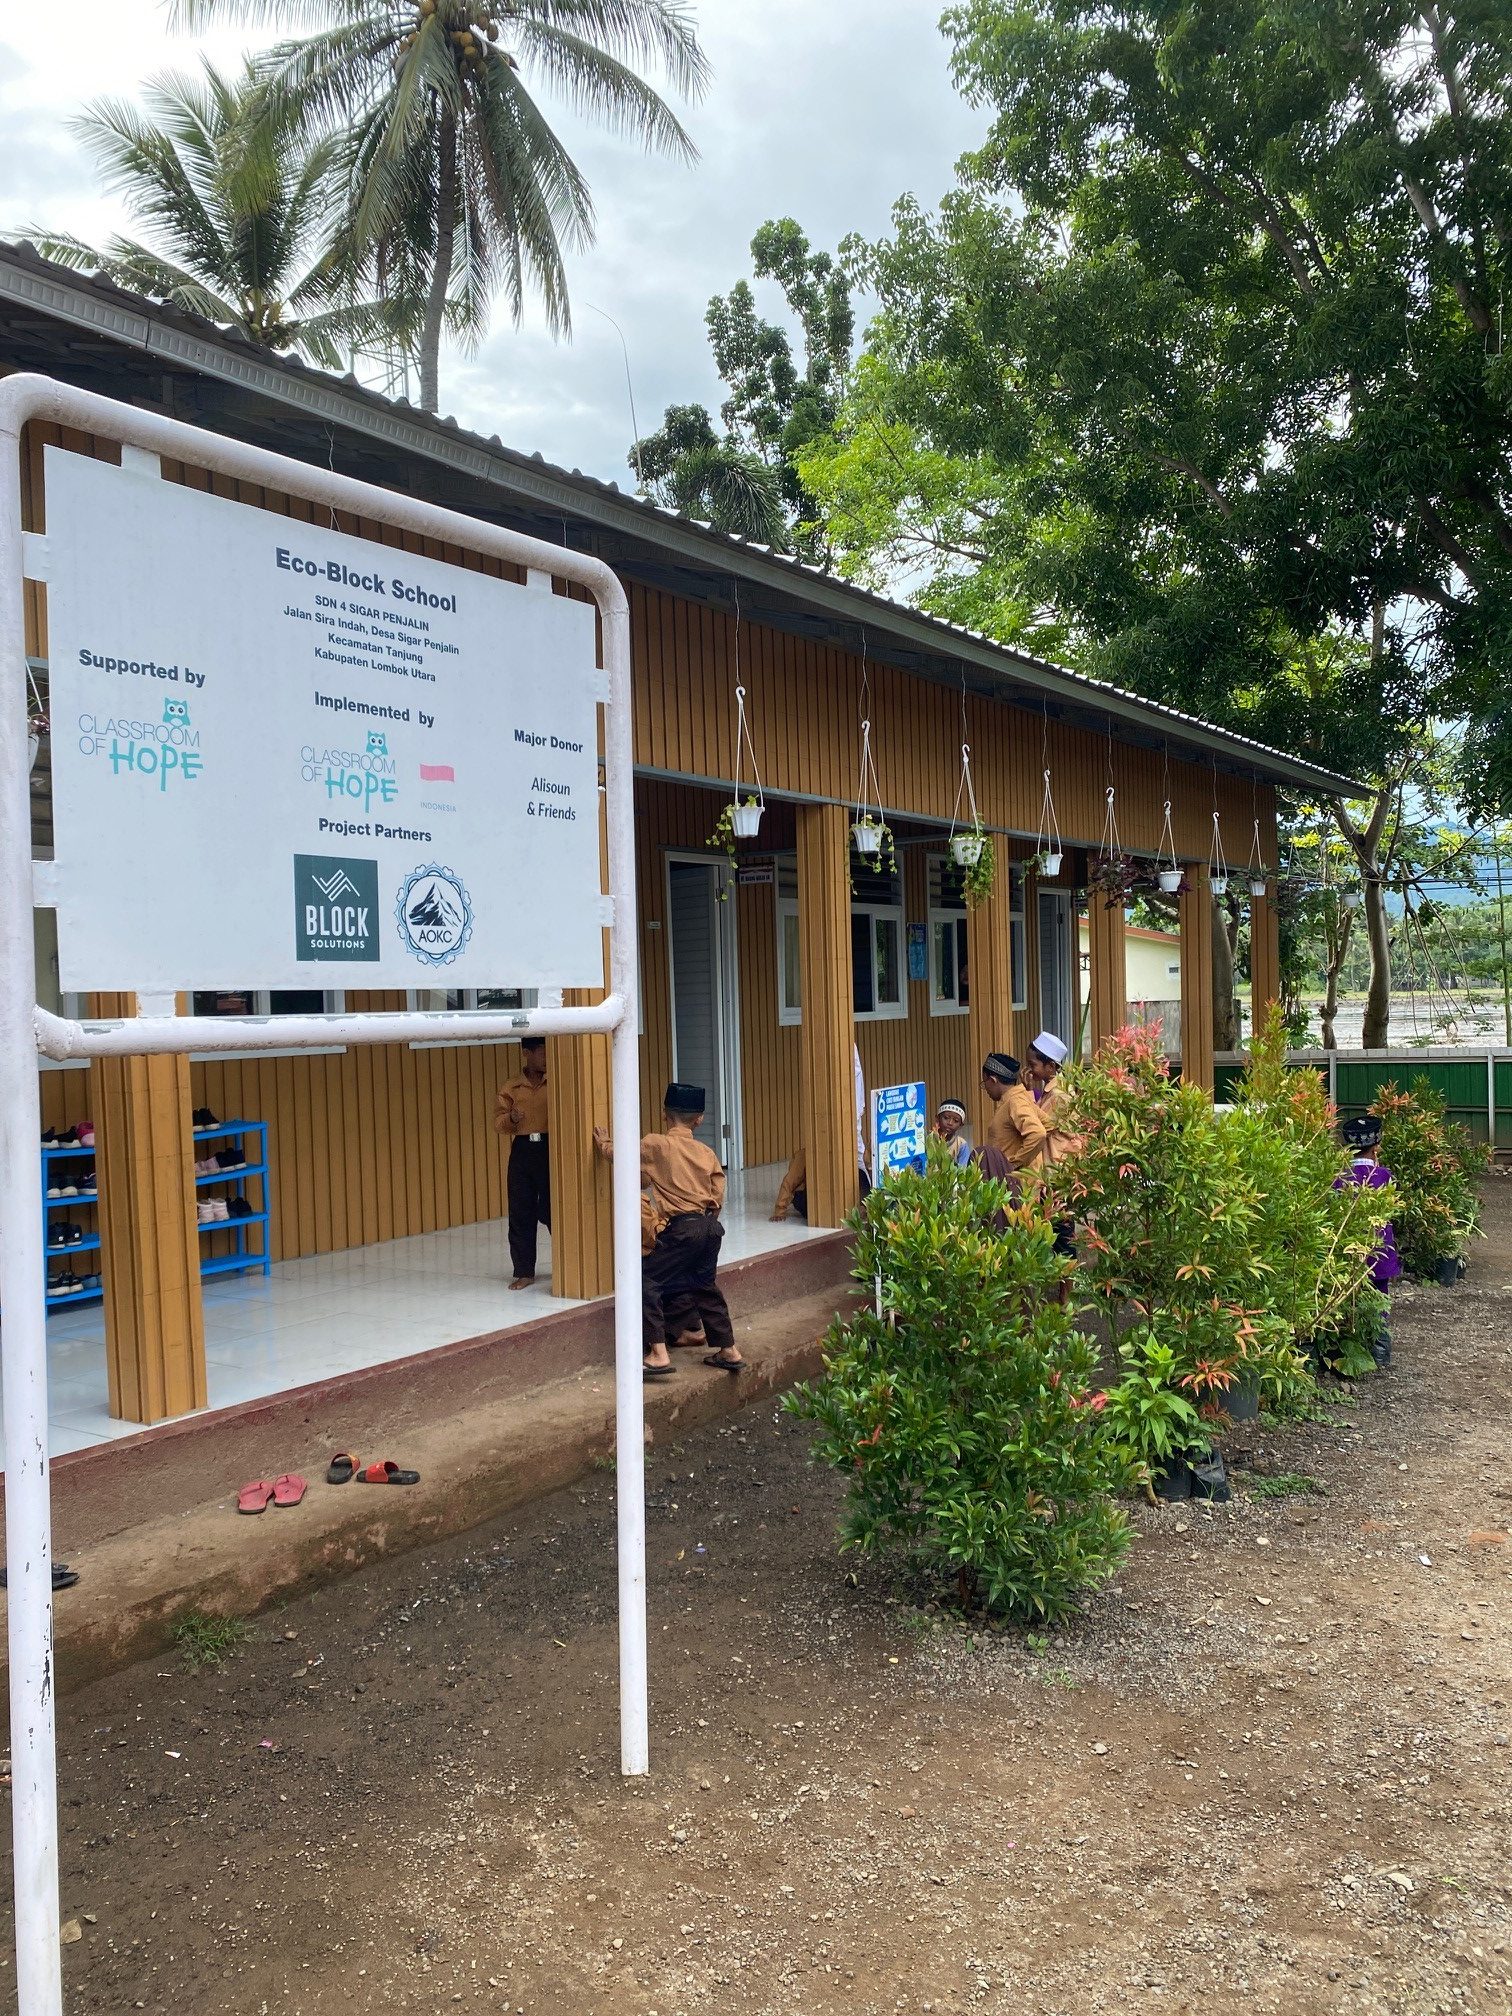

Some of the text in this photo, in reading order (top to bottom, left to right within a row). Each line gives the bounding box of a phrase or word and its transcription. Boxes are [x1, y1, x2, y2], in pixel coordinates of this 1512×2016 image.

[276, 547, 456, 613] Eco-Block School
[283, 605, 460, 655] Jalan Sira Indah, Desa Sigar Penjalin
[315, 595, 429, 632] SDN 4 SIGAR PENJALIN
[314, 647, 436, 682] Kabupaten Lombok Utara
[328, 632, 423, 665] Kecamatan Tanjung
[79, 649, 206, 688] Supported by
[315, 691, 435, 728] Implemented by
[79, 714, 200, 748] CLASSROOM
[514, 729, 584, 753] Major Donor
[79, 736, 204, 792] OF HOPE
[301, 745, 396, 774] CLASSROOM
[301, 765, 399, 813] OF HOPE
[531, 777, 571, 796] Alisoun
[420, 802, 457, 812] INDONESIA
[527, 801, 577, 821] & Friends
[319, 818, 432, 842] Project Partners
[306, 905, 369, 937] BLOCK
[418, 929, 453, 943] AOKC
[311, 939, 365, 949] SOLUTIONS
